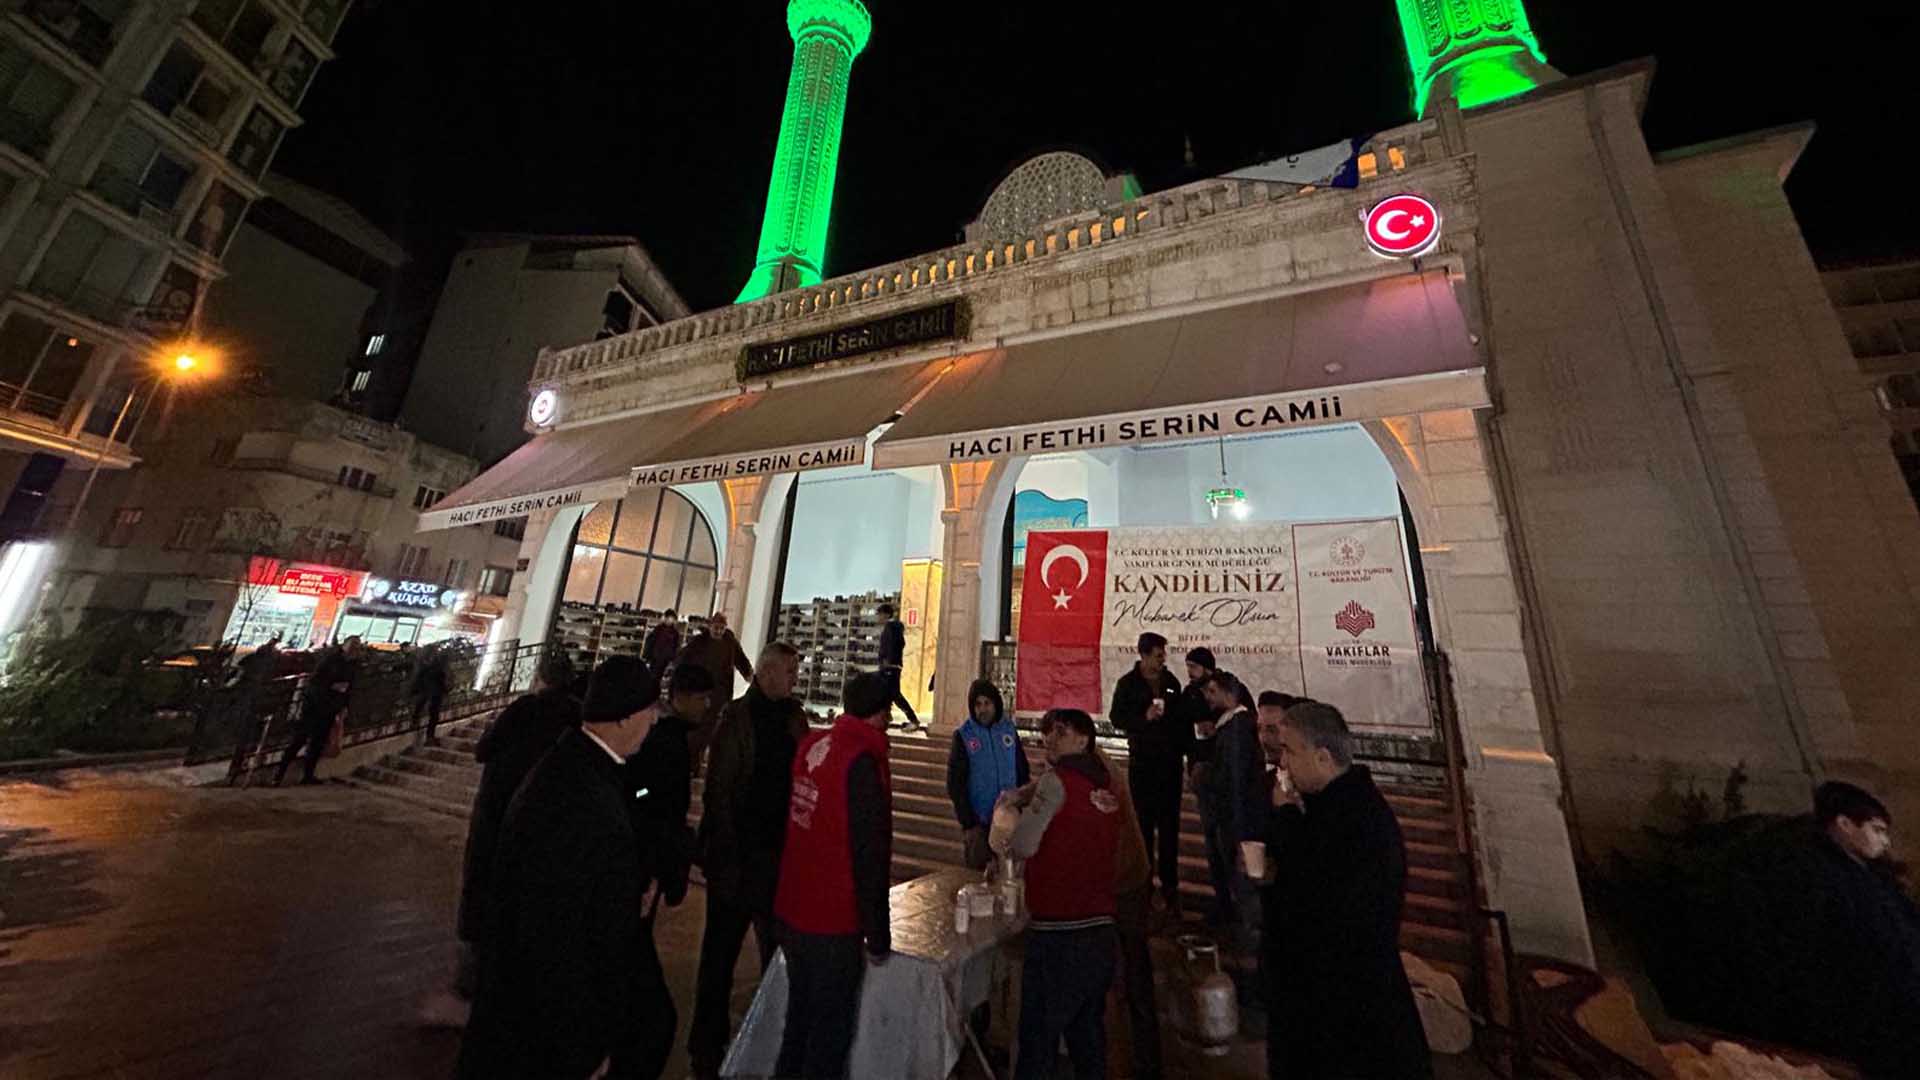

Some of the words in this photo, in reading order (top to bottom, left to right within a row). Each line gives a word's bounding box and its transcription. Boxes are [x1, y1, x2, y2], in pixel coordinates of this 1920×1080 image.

[950, 437, 1011, 458] HACI
[636, 469, 674, 485] HACI
[449, 511, 473, 523] HACI
[1171, 548, 1182, 556] VE
[1124, 560, 1169, 568] VAKIFLAR
[398, 581, 438, 593] AZAD
[1114, 569, 1285, 593] KANDİLİNİZ
[1326, 646, 1390, 656] VAKIFLAR
